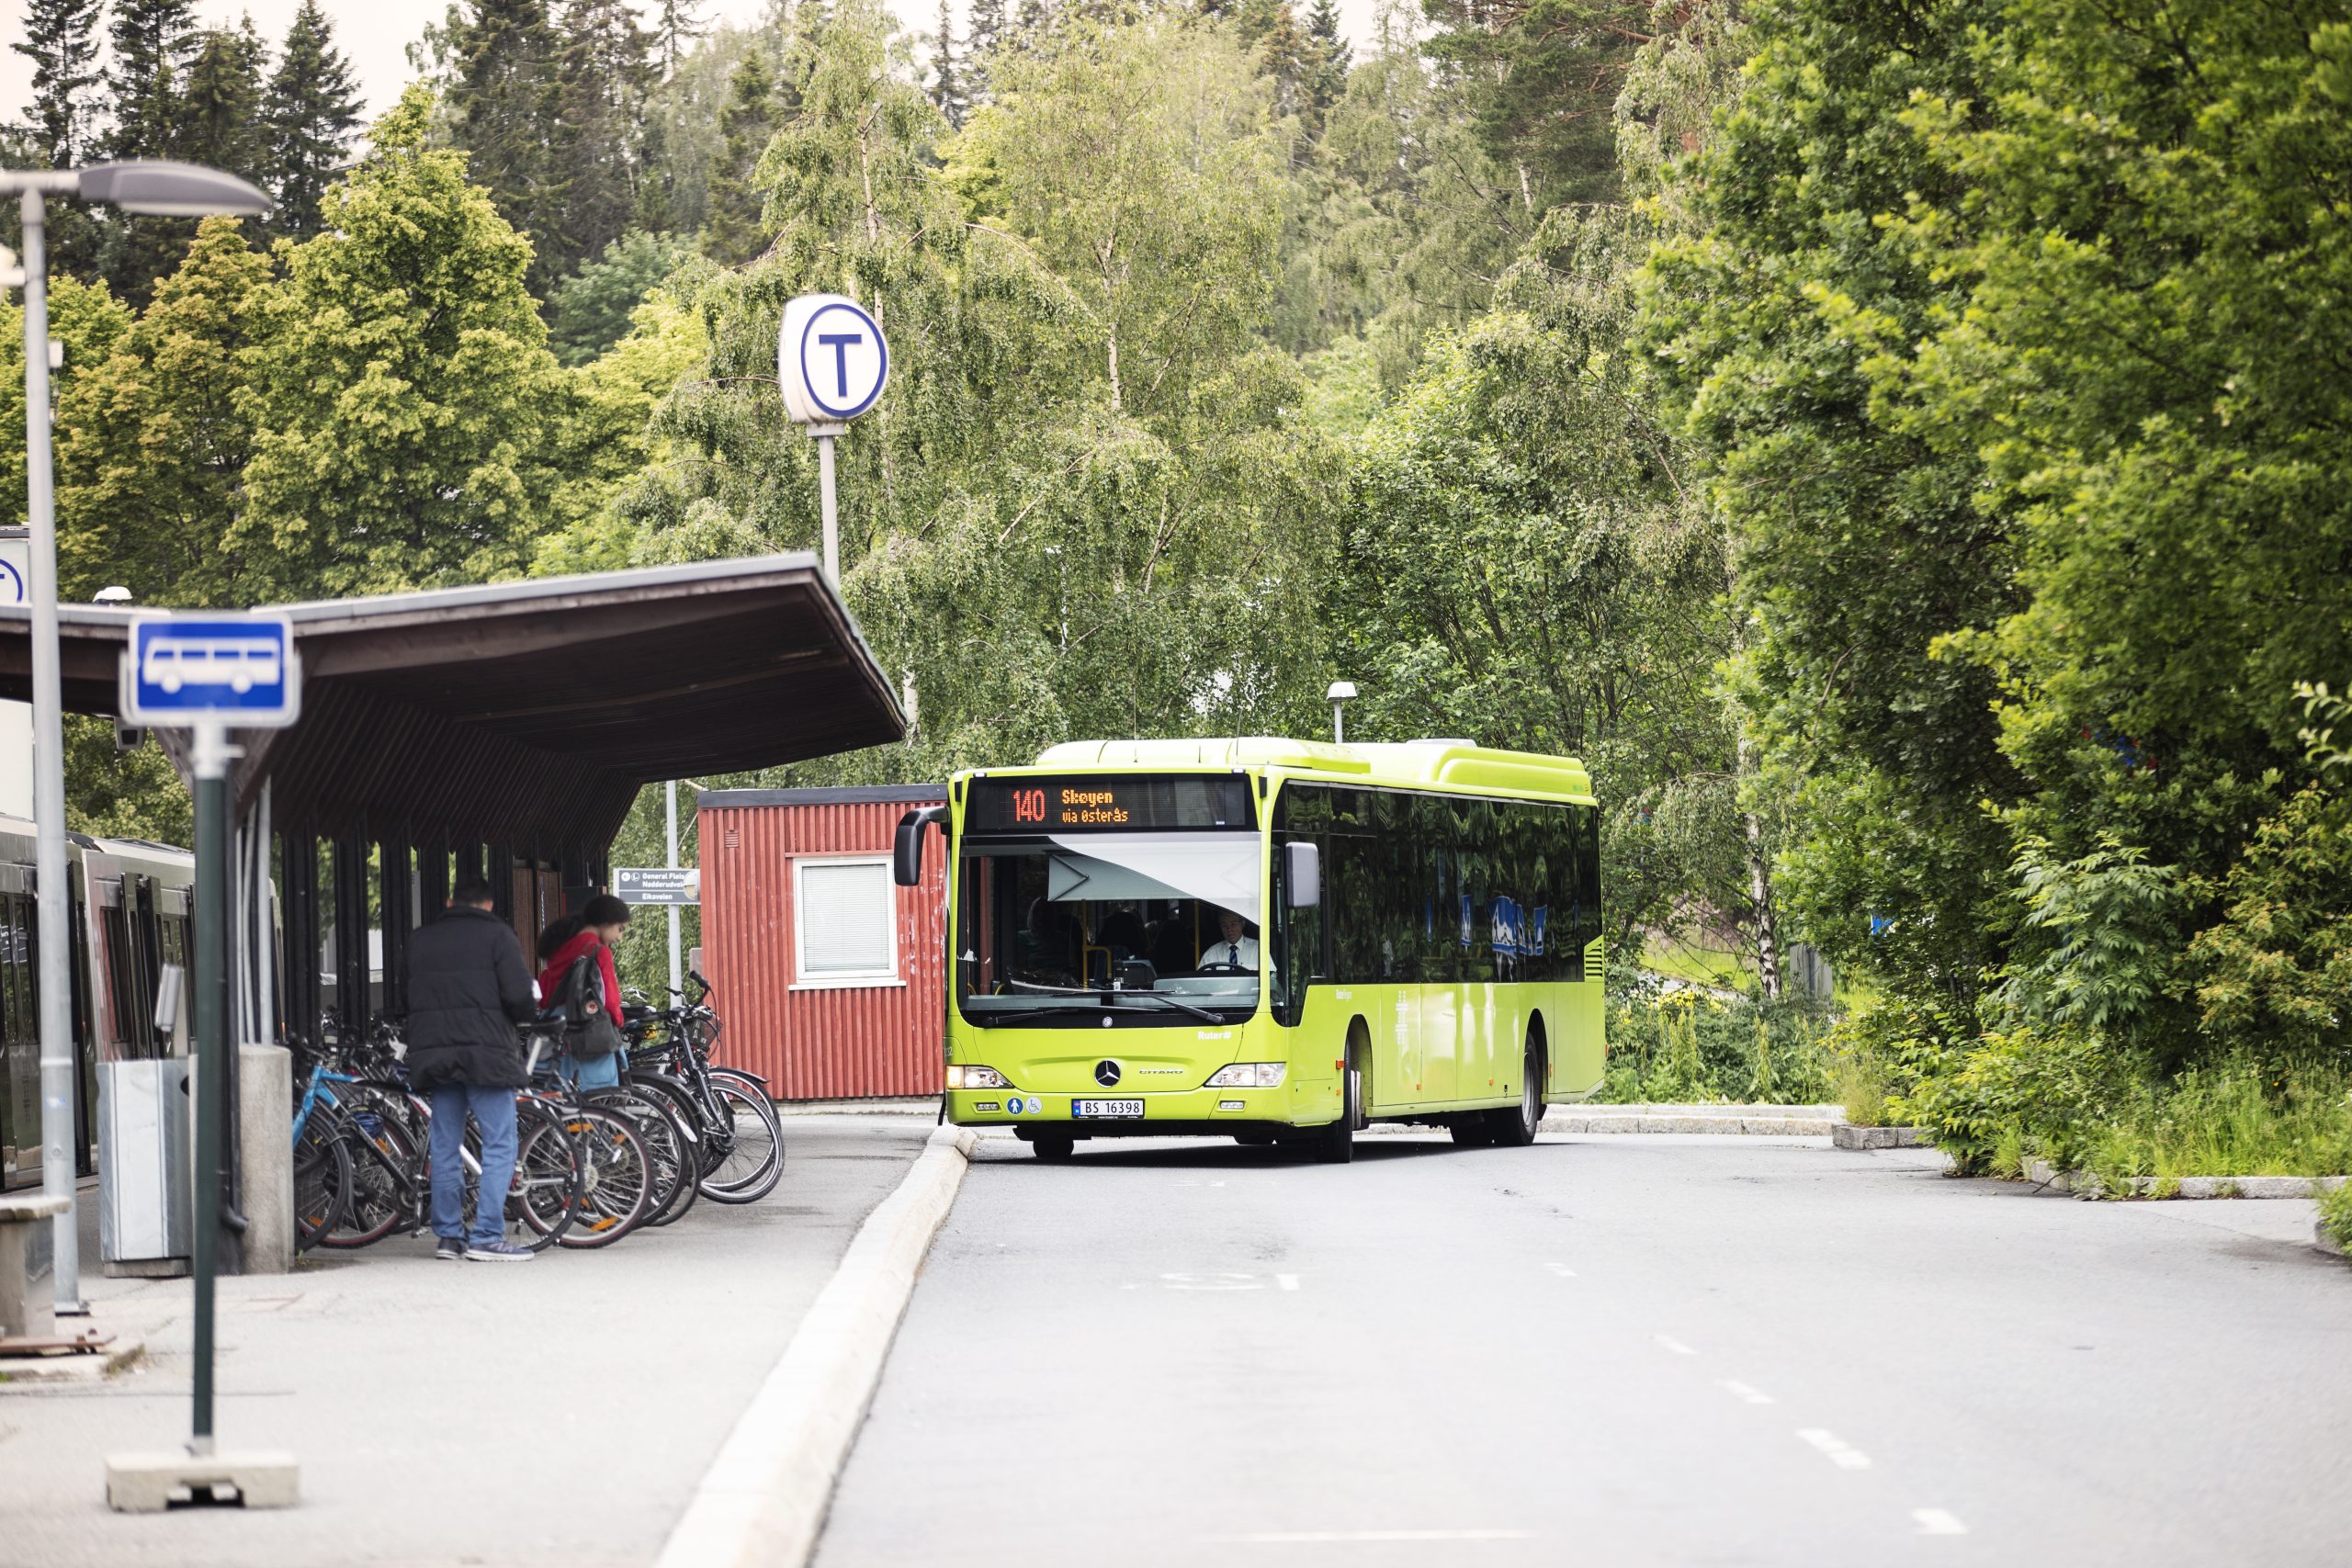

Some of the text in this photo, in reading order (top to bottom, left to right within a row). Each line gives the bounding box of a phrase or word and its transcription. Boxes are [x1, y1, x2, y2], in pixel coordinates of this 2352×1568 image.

[819, 333, 862, 398] T
[1012, 789, 1046, 822] 140
[1061, 789, 1114, 807] Skøyen
[1062, 807, 1129, 822] via Østerås
[1085, 1102, 1140, 1113] BS 16398
